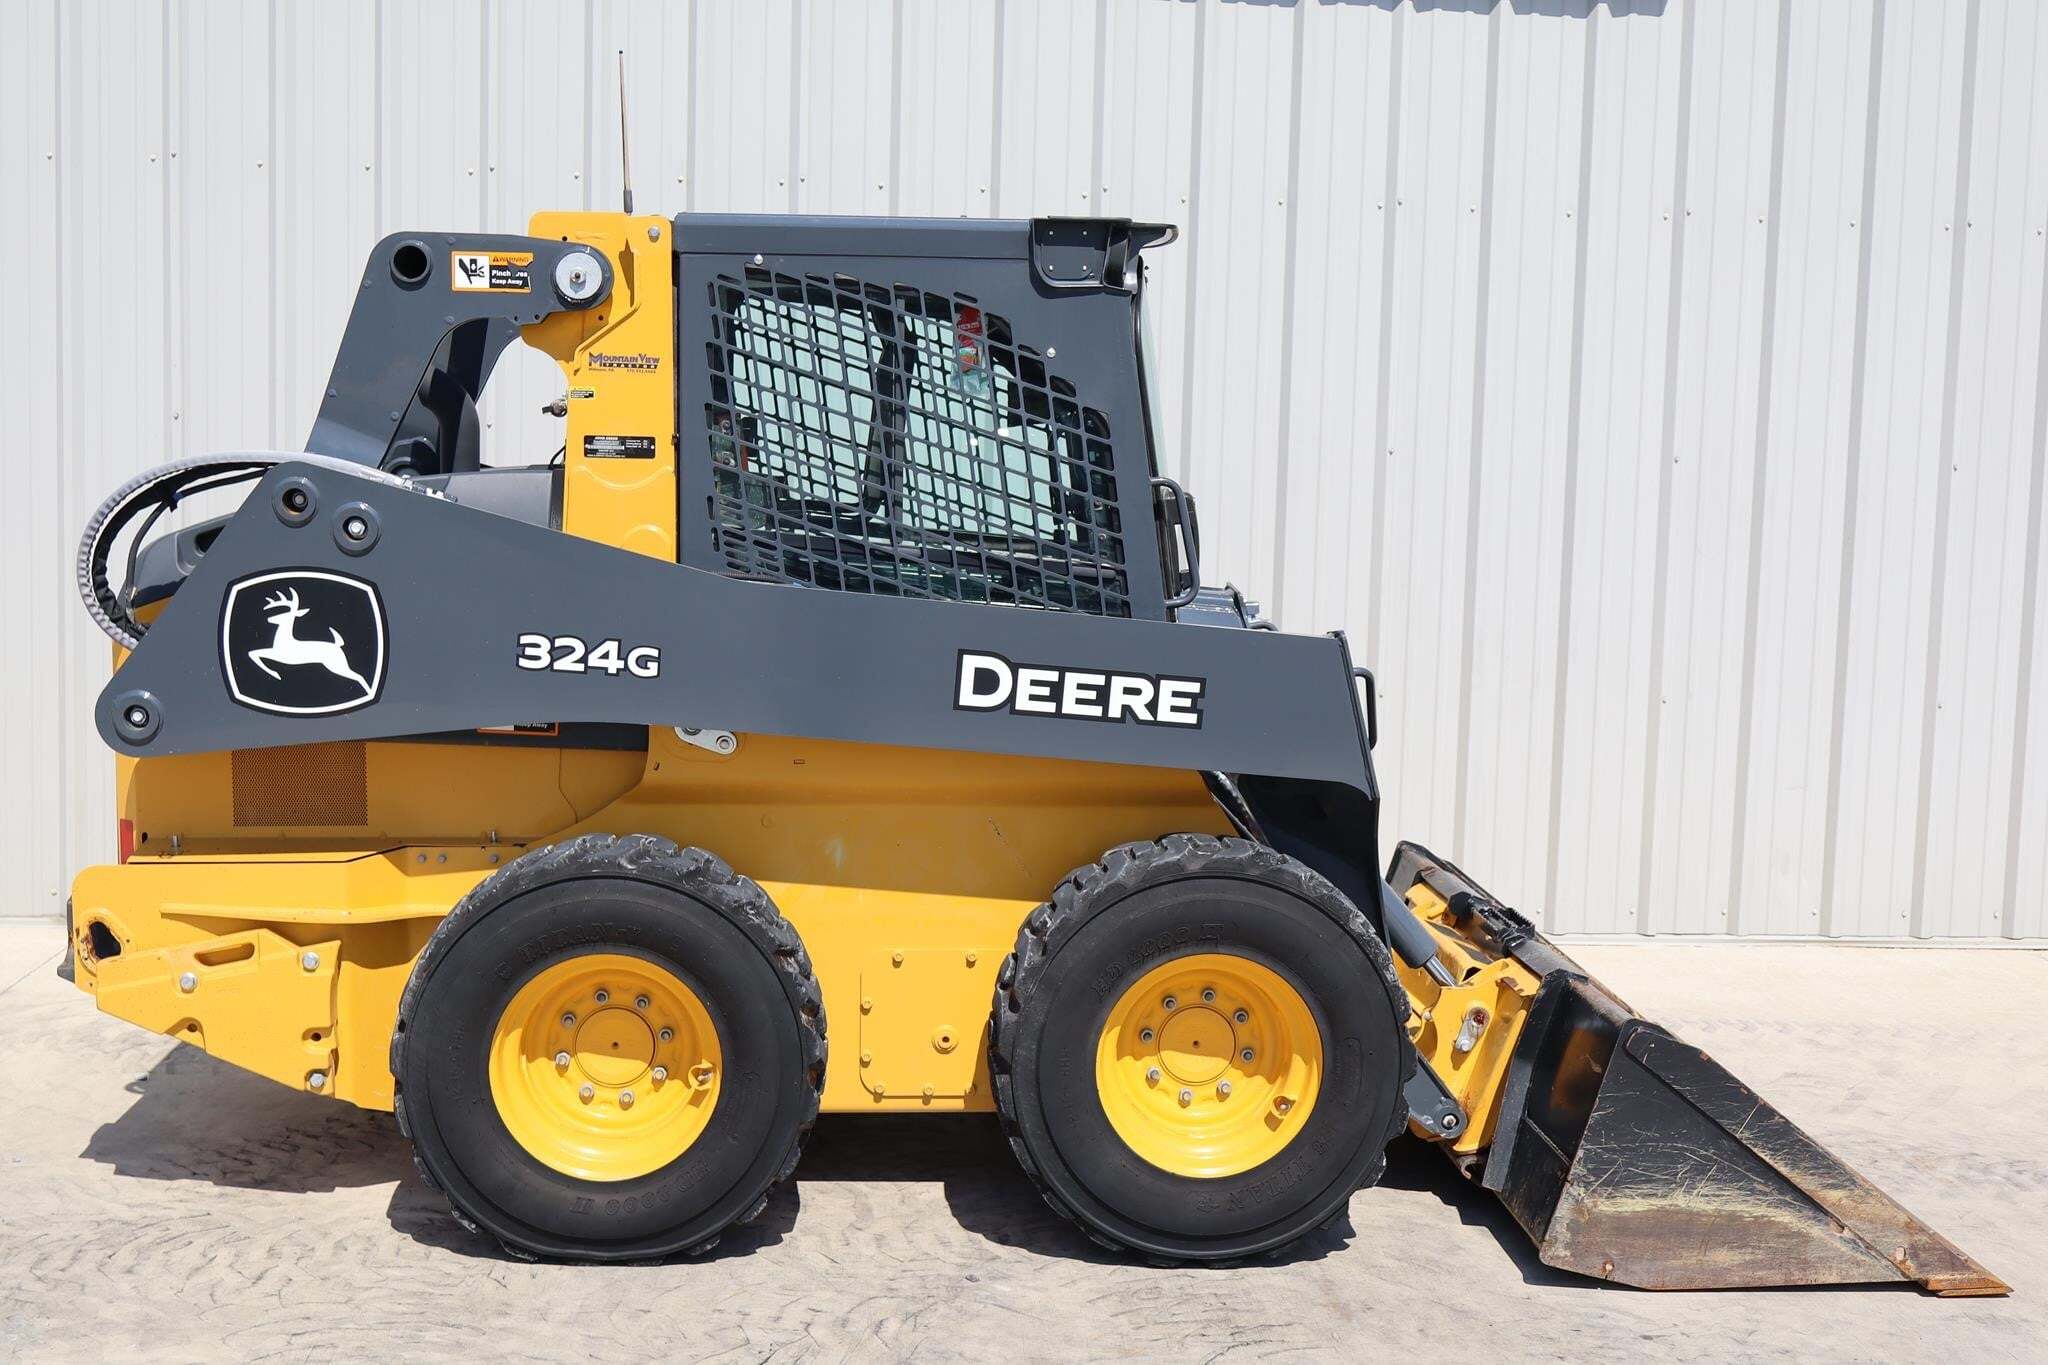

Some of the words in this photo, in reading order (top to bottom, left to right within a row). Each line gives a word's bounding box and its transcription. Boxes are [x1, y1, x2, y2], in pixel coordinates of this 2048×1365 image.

[491, 269, 512, 277] Pinch
[507, 278, 523, 286] Away
[518, 633, 660, 678] 324G
[957, 653, 1202, 725] DEERE
